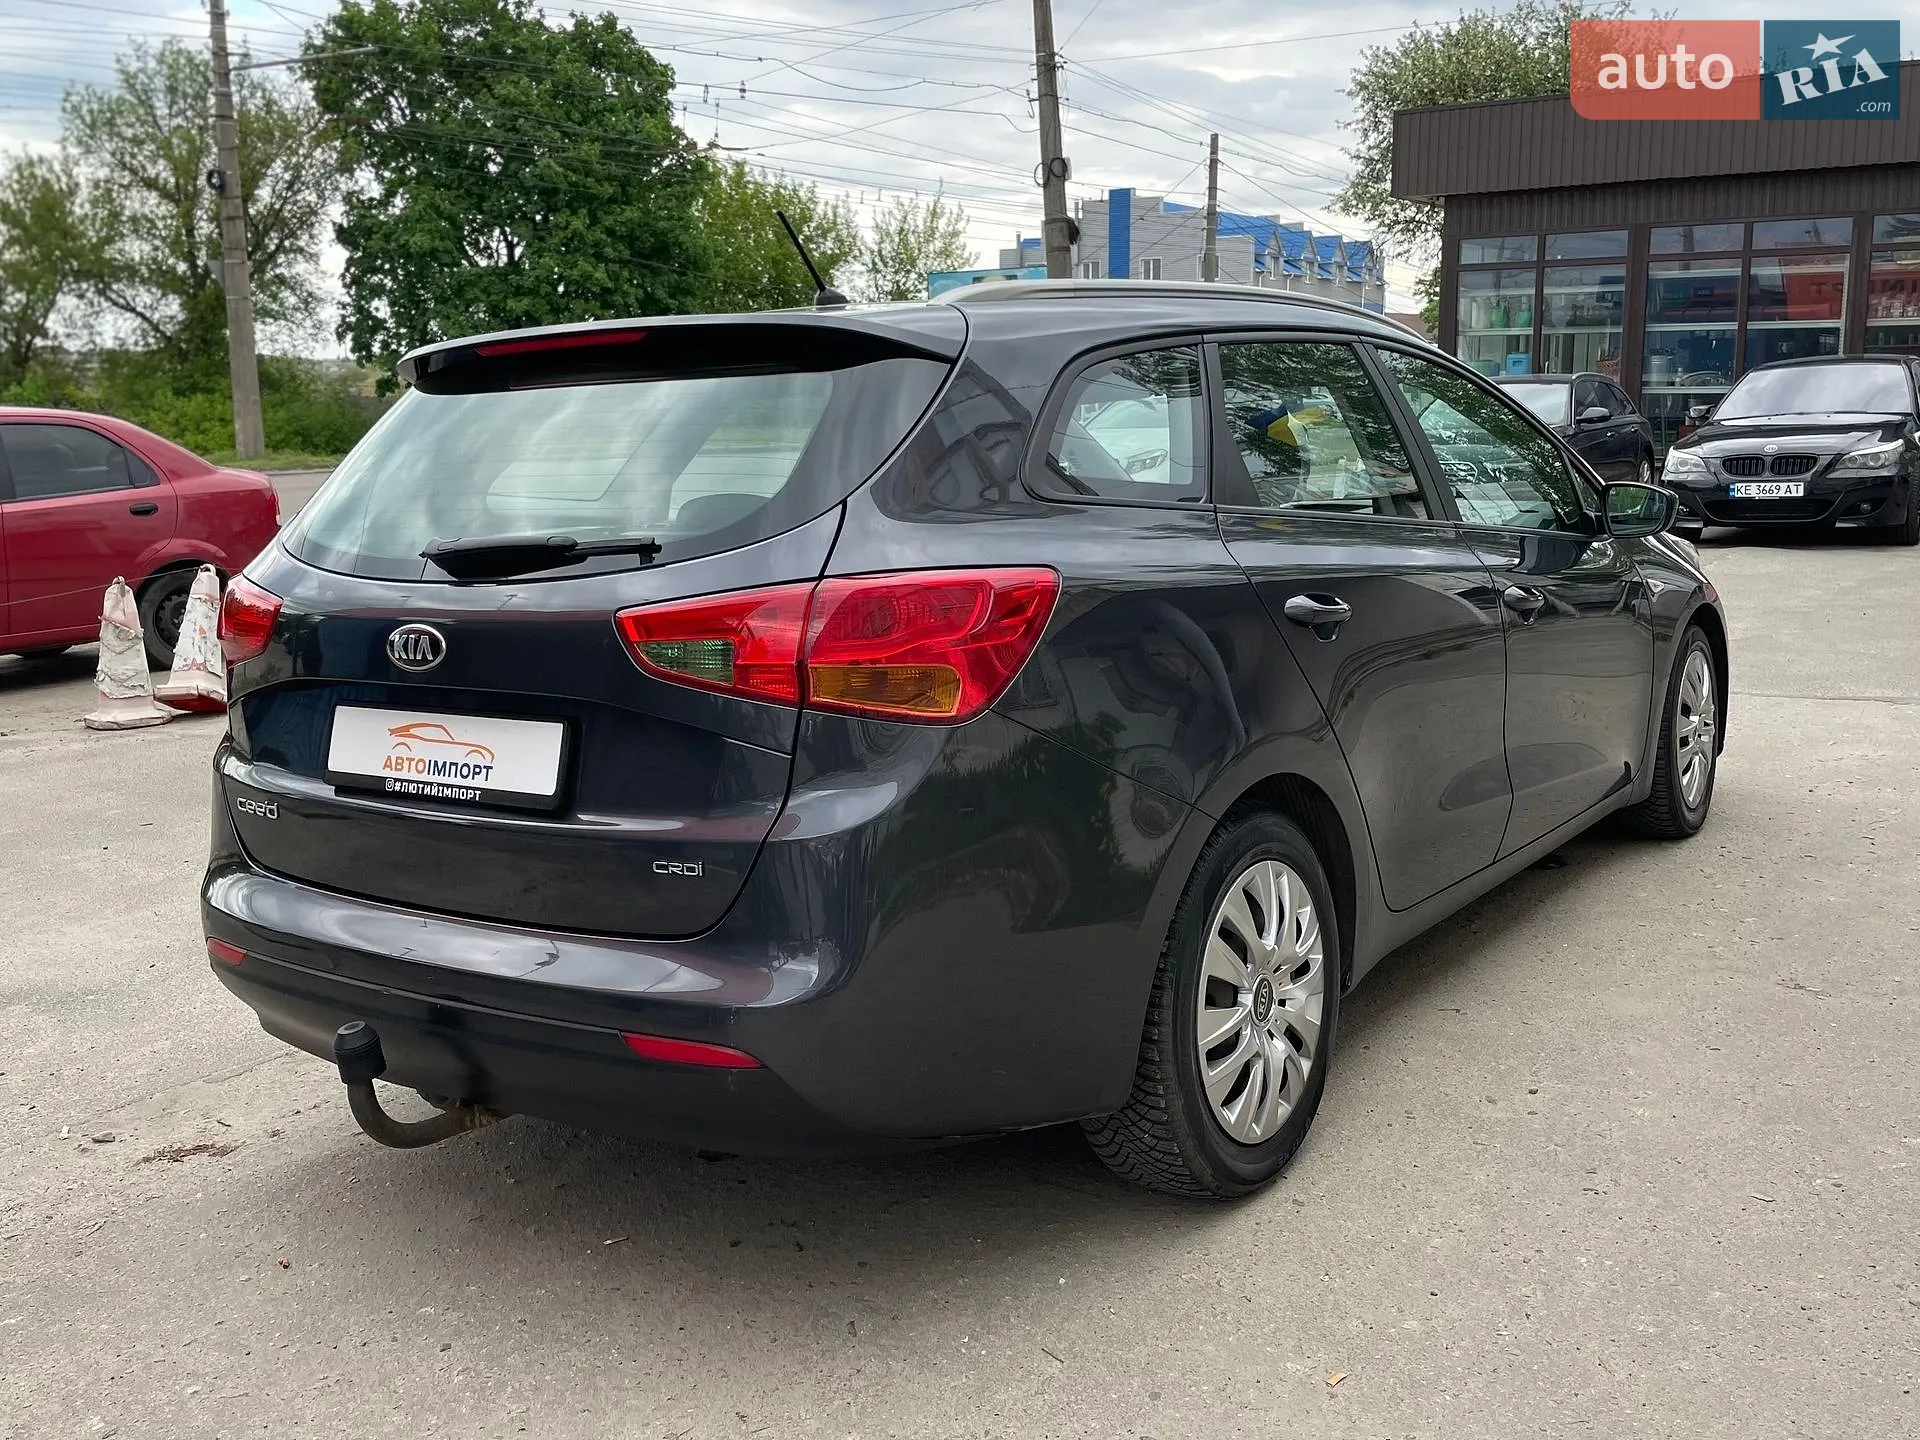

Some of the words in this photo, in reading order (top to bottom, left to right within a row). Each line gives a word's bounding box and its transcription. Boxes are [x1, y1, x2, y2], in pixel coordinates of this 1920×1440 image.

[1736, 484, 1752, 495] KE
[1755, 484, 1781, 495] 3669
[1784, 484, 1802, 495] AT
[391, 634, 434, 661] KIA
[382, 754, 494, 782] АВТОІМПОРТ
[394, 780, 482, 801] #ЛЮТИЙІМПОРТ
[652, 861, 703, 877] CRDi
